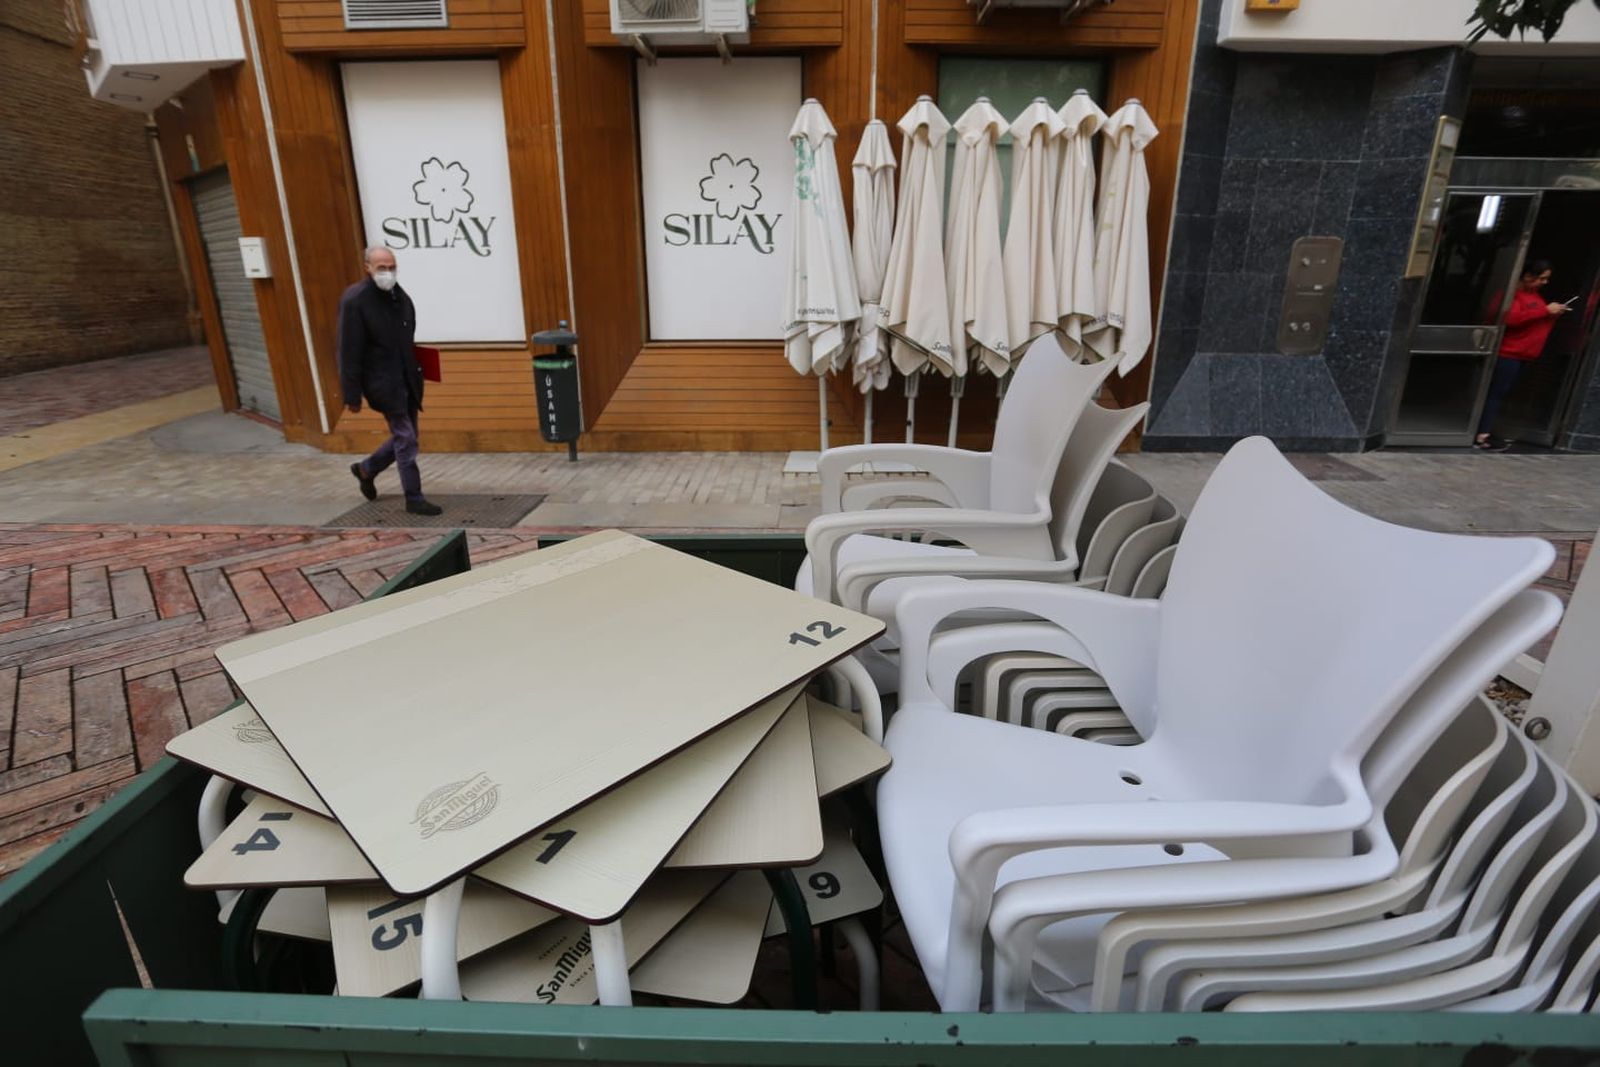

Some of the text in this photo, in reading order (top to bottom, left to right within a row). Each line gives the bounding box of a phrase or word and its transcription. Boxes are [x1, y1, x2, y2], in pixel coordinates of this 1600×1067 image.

[382, 217, 496, 257] SILAY
[663, 213, 782, 254] SILAY
[789, 621, 847, 647] 12
[231, 812, 294, 855] 14
[809, 871, 841, 899] 9
[536, 925, 592, 1005] SanMigu
